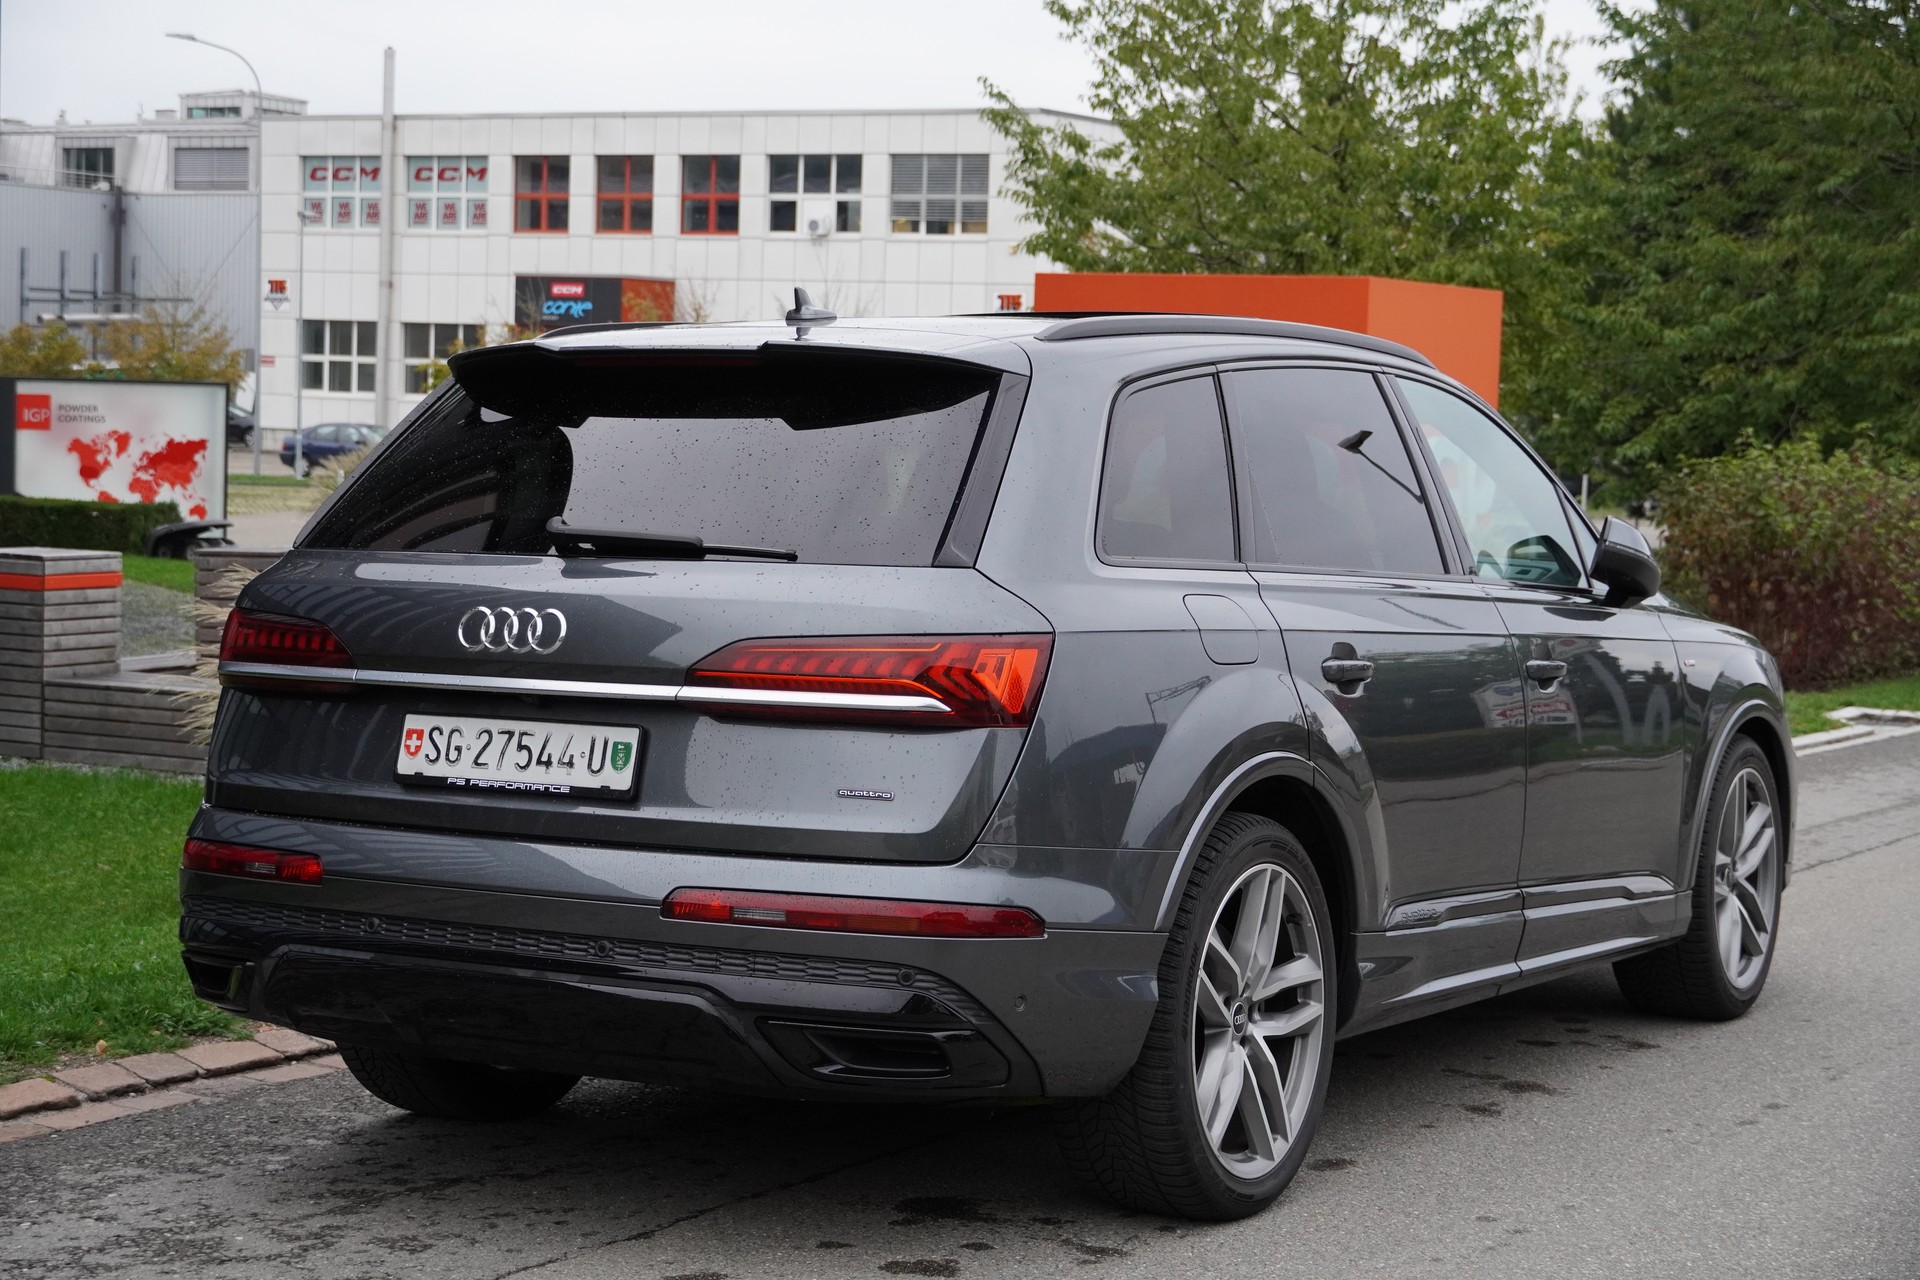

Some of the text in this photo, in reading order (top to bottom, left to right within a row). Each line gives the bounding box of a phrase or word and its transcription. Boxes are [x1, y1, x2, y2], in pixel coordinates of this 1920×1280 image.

[309, 167, 381, 181] CCM
[415, 167, 487, 181] CCM
[552, 285, 584, 294] CCM
[58, 404, 99, 413] POWDER
[23, 408, 50, 422] IGP
[58, 414, 106, 423] COATINGS
[447, 777, 571, 793] PS PERFORMANCE
[839, 790, 891, 798] quattro
